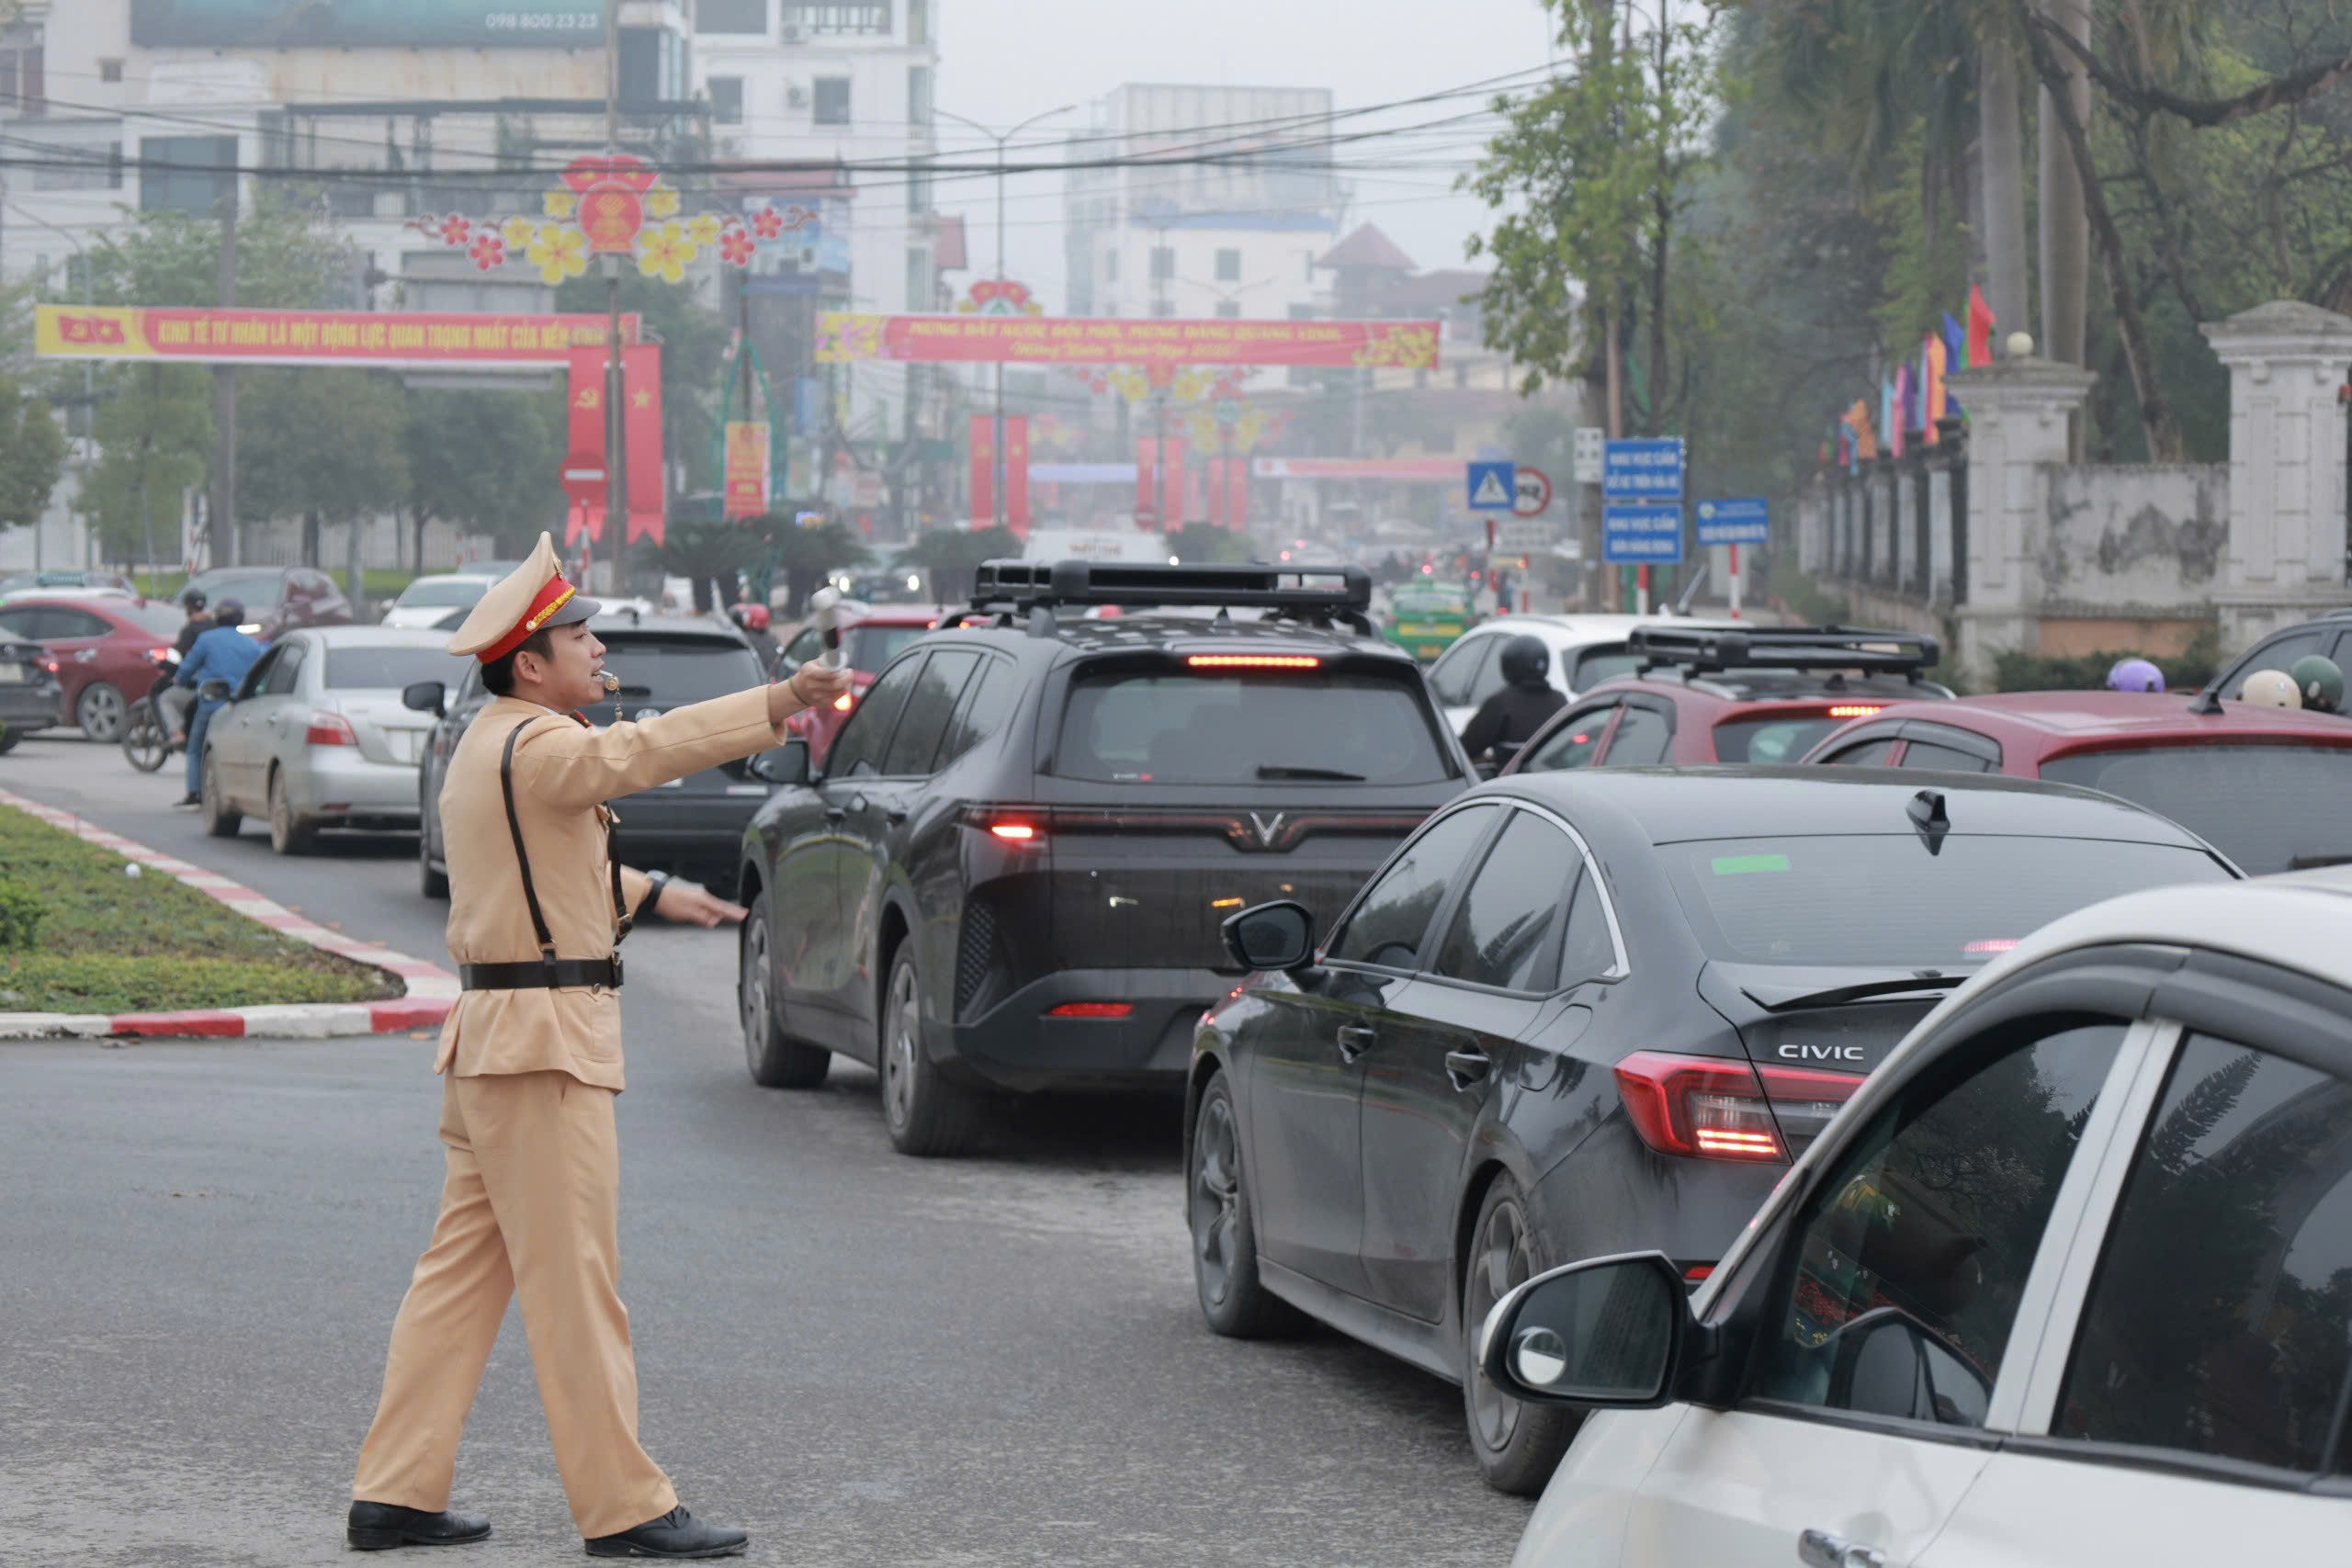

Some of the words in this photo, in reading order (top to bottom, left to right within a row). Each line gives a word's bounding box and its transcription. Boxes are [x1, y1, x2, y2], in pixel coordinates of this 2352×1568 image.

[485, 12, 515, 29] 098
[521, 12, 552, 29] 800
[157, 320, 191, 345] KINH
[194, 315, 209, 344] TẾ
[212, 318, 229, 345] TƯ
[232, 316, 267, 346] NHÂN
[270, 316, 288, 346] LÀ
[290, 317, 319, 352] MỘT
[321, 318, 358, 353] ĐỘNG
[359, 321, 387, 353] LỰC
[389, 324, 424, 348] QUAN
[427, 325, 471, 353] TRỌNG
[473, 317, 508, 349] NHẤT
[510, 320, 537, 350] CỦA
[1779, 1043, 1864, 1061] CIVIC
